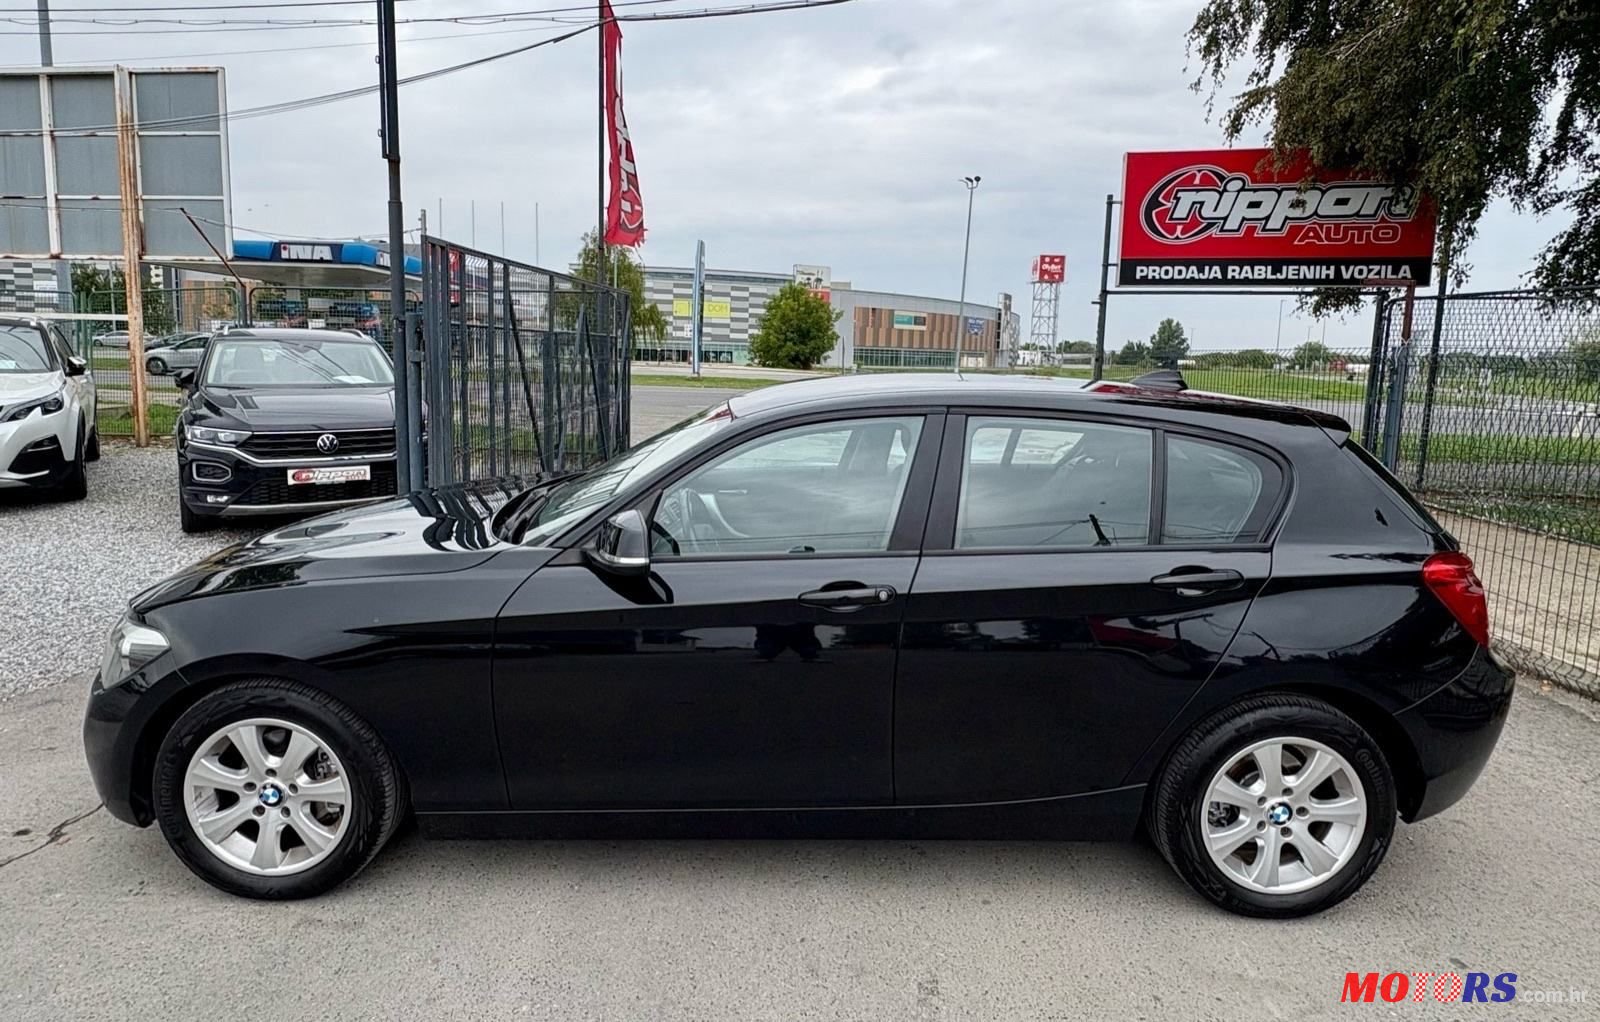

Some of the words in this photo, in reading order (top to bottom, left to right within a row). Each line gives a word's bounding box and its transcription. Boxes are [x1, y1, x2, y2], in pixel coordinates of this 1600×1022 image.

[1294, 224, 1401, 245] AUTO
[1135, 265, 1221, 280] PRODAJA
[1227, 265, 1335, 280] RABLJENIH
[1340, 265, 1412, 280] VOZILA
